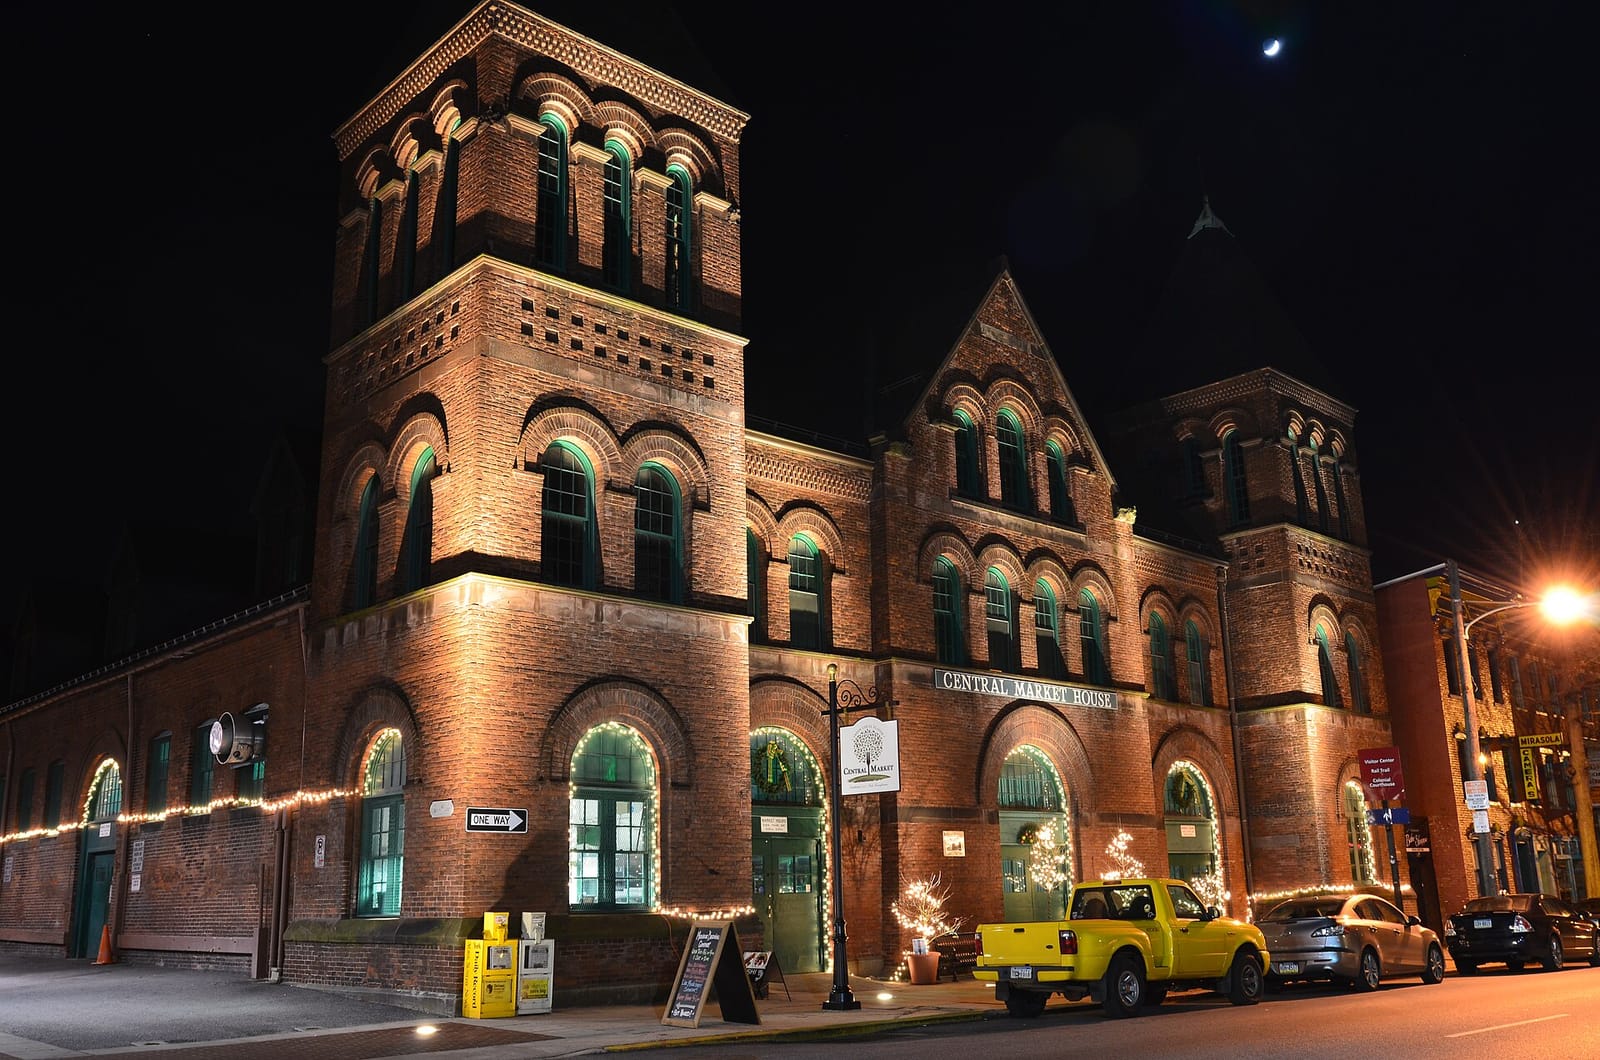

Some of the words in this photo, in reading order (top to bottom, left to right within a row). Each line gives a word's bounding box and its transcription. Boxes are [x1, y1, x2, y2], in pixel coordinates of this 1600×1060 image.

[943, 672, 1008, 695] CENTRAL
[1013, 681, 1068, 701] MARKET
[1072, 689, 1112, 708] HOUSE
[1520, 735, 1560, 746] MIRASOLA
[843, 767, 867, 776] CENTRAL
[870, 764, 894, 773] MARKET
[472, 814, 489, 825] ONE
[493, 815, 510, 825] WAY
[472, 951, 480, 973] Daily
